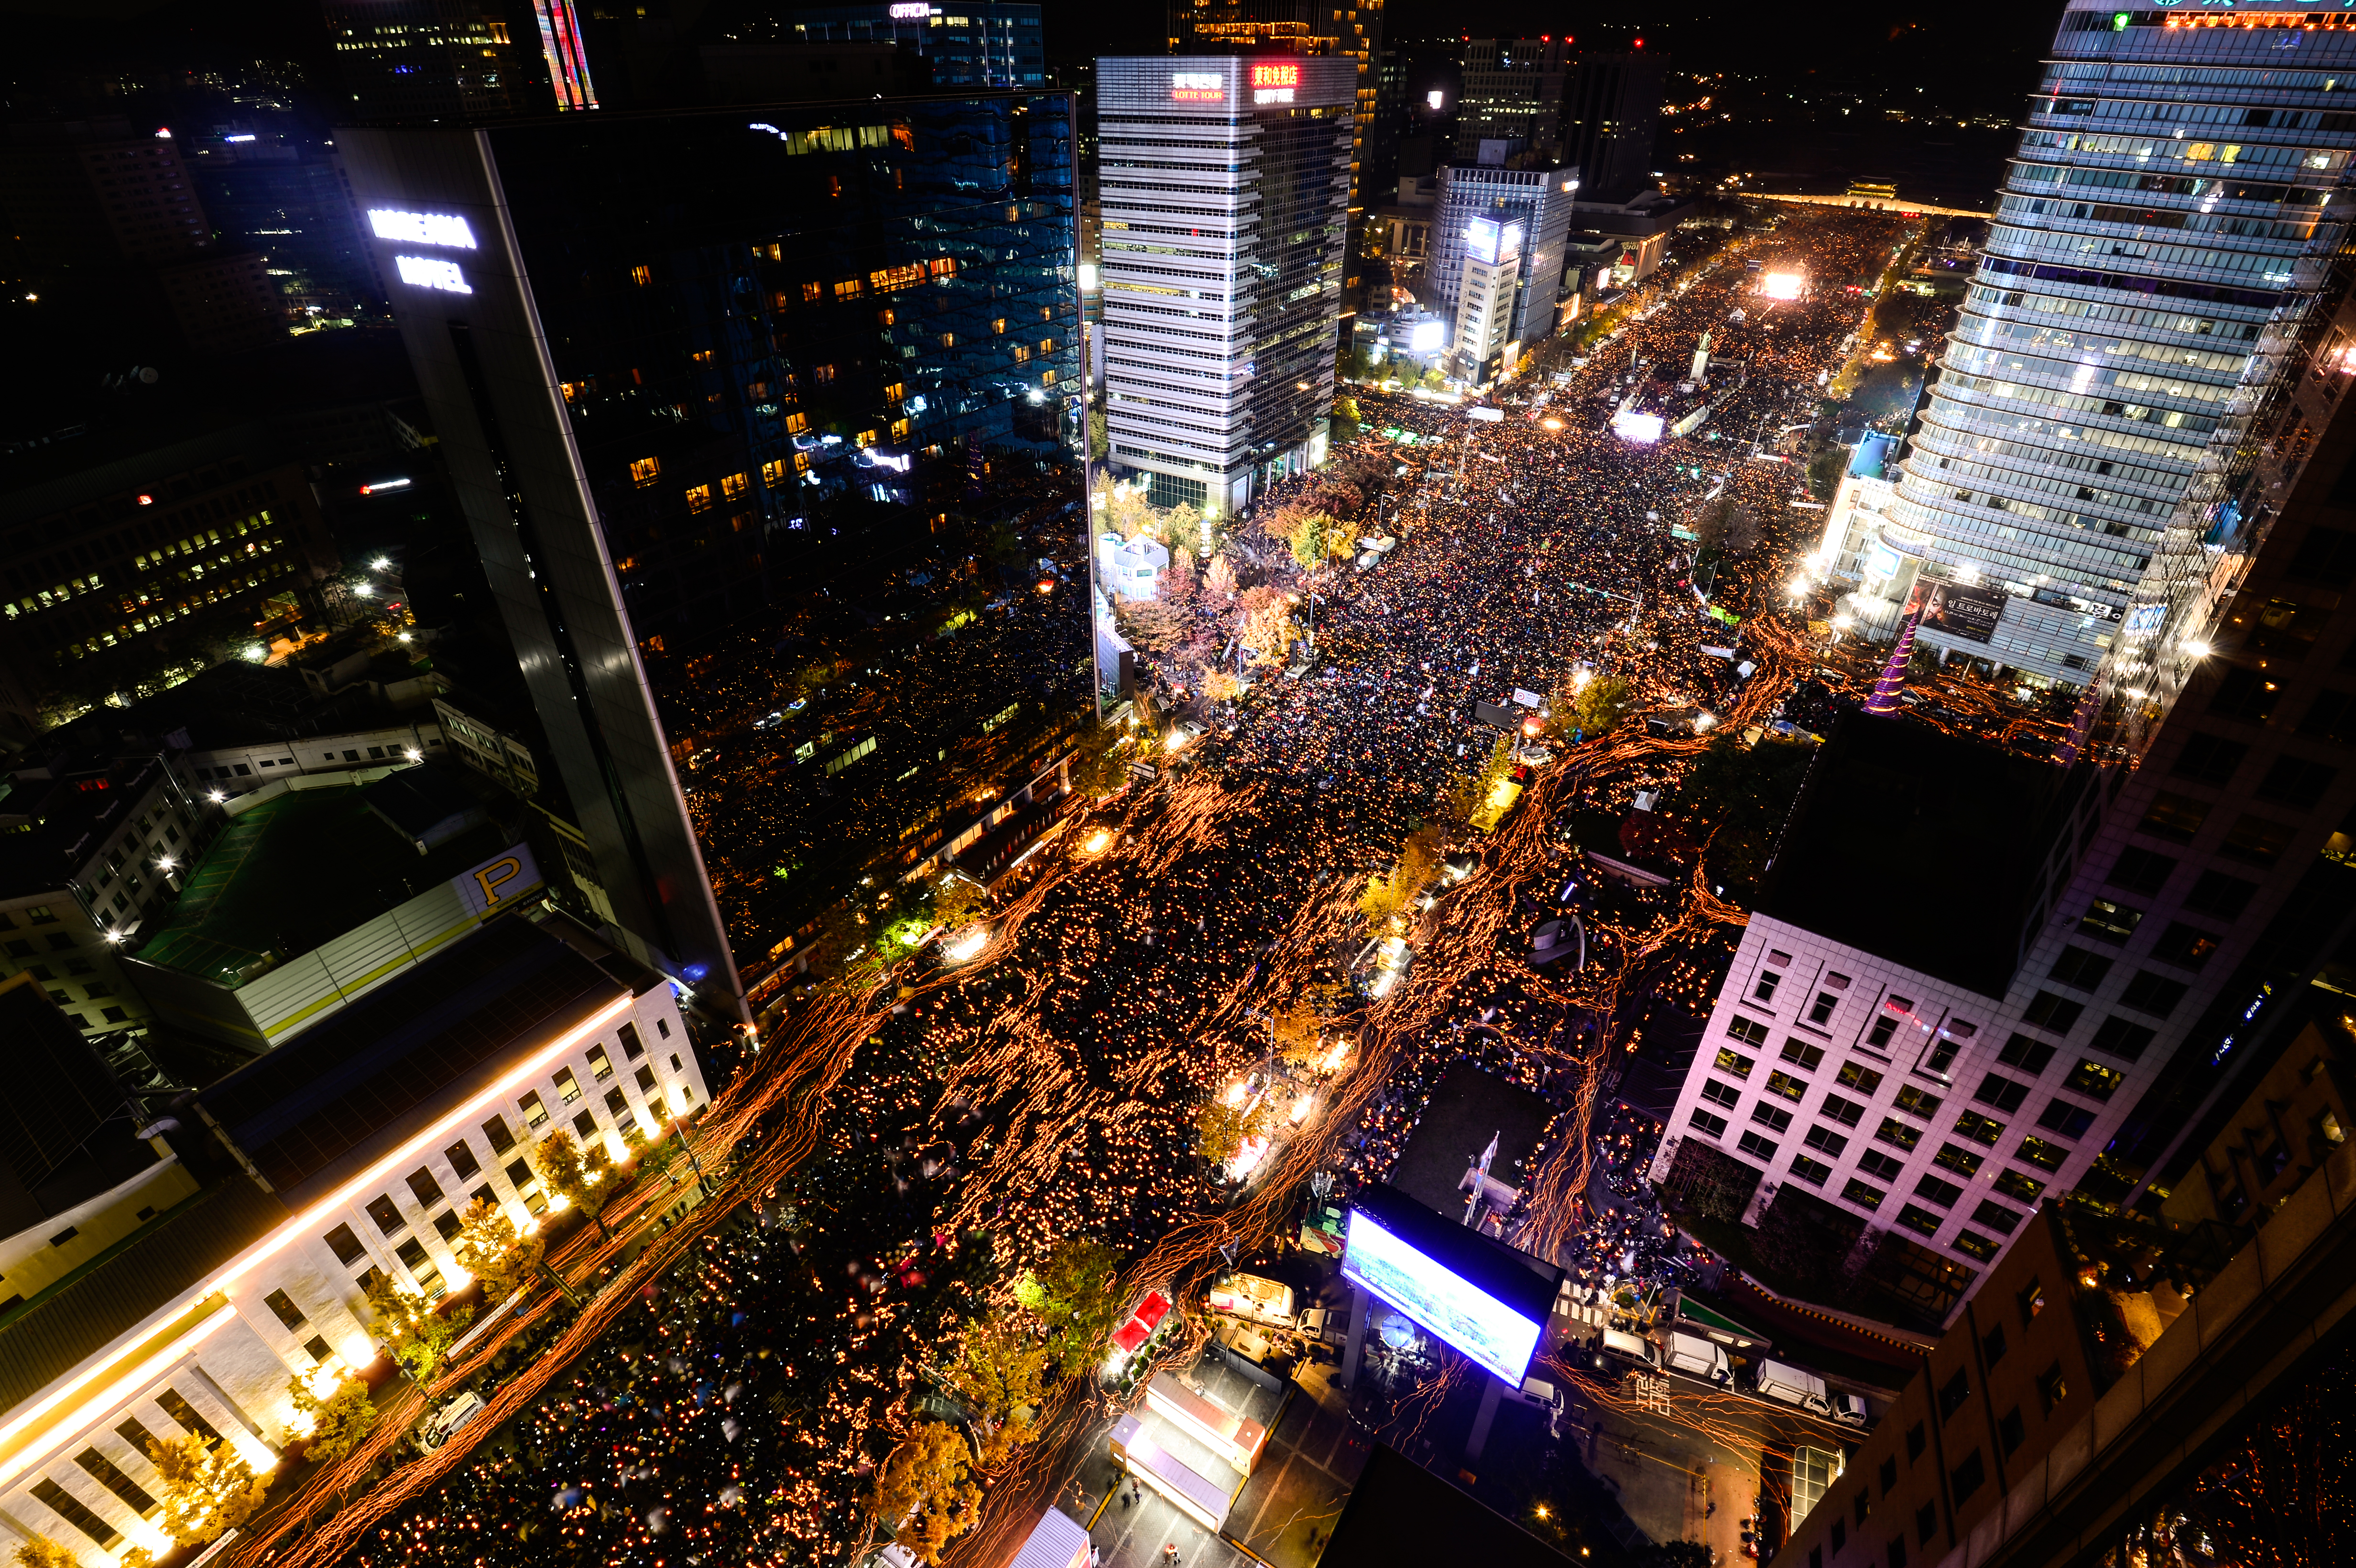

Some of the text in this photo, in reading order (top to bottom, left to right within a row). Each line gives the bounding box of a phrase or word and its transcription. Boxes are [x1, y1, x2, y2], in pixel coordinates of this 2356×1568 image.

[890, 3, 930, 18] OFFICIA
[1174, 91, 1199, 99] LOTTE
[367, 209, 477, 249] KOREANA
[395, 255, 472, 294] HOTEL
[1948, 599, 1956, 609] 일
[1956, 603, 1999, 620] 트로바토레
[472, 856, 522, 907] P
[497, 887, 534, 909] KOREANA HOTEL
[523, 892, 544, 906] 주차장입구
